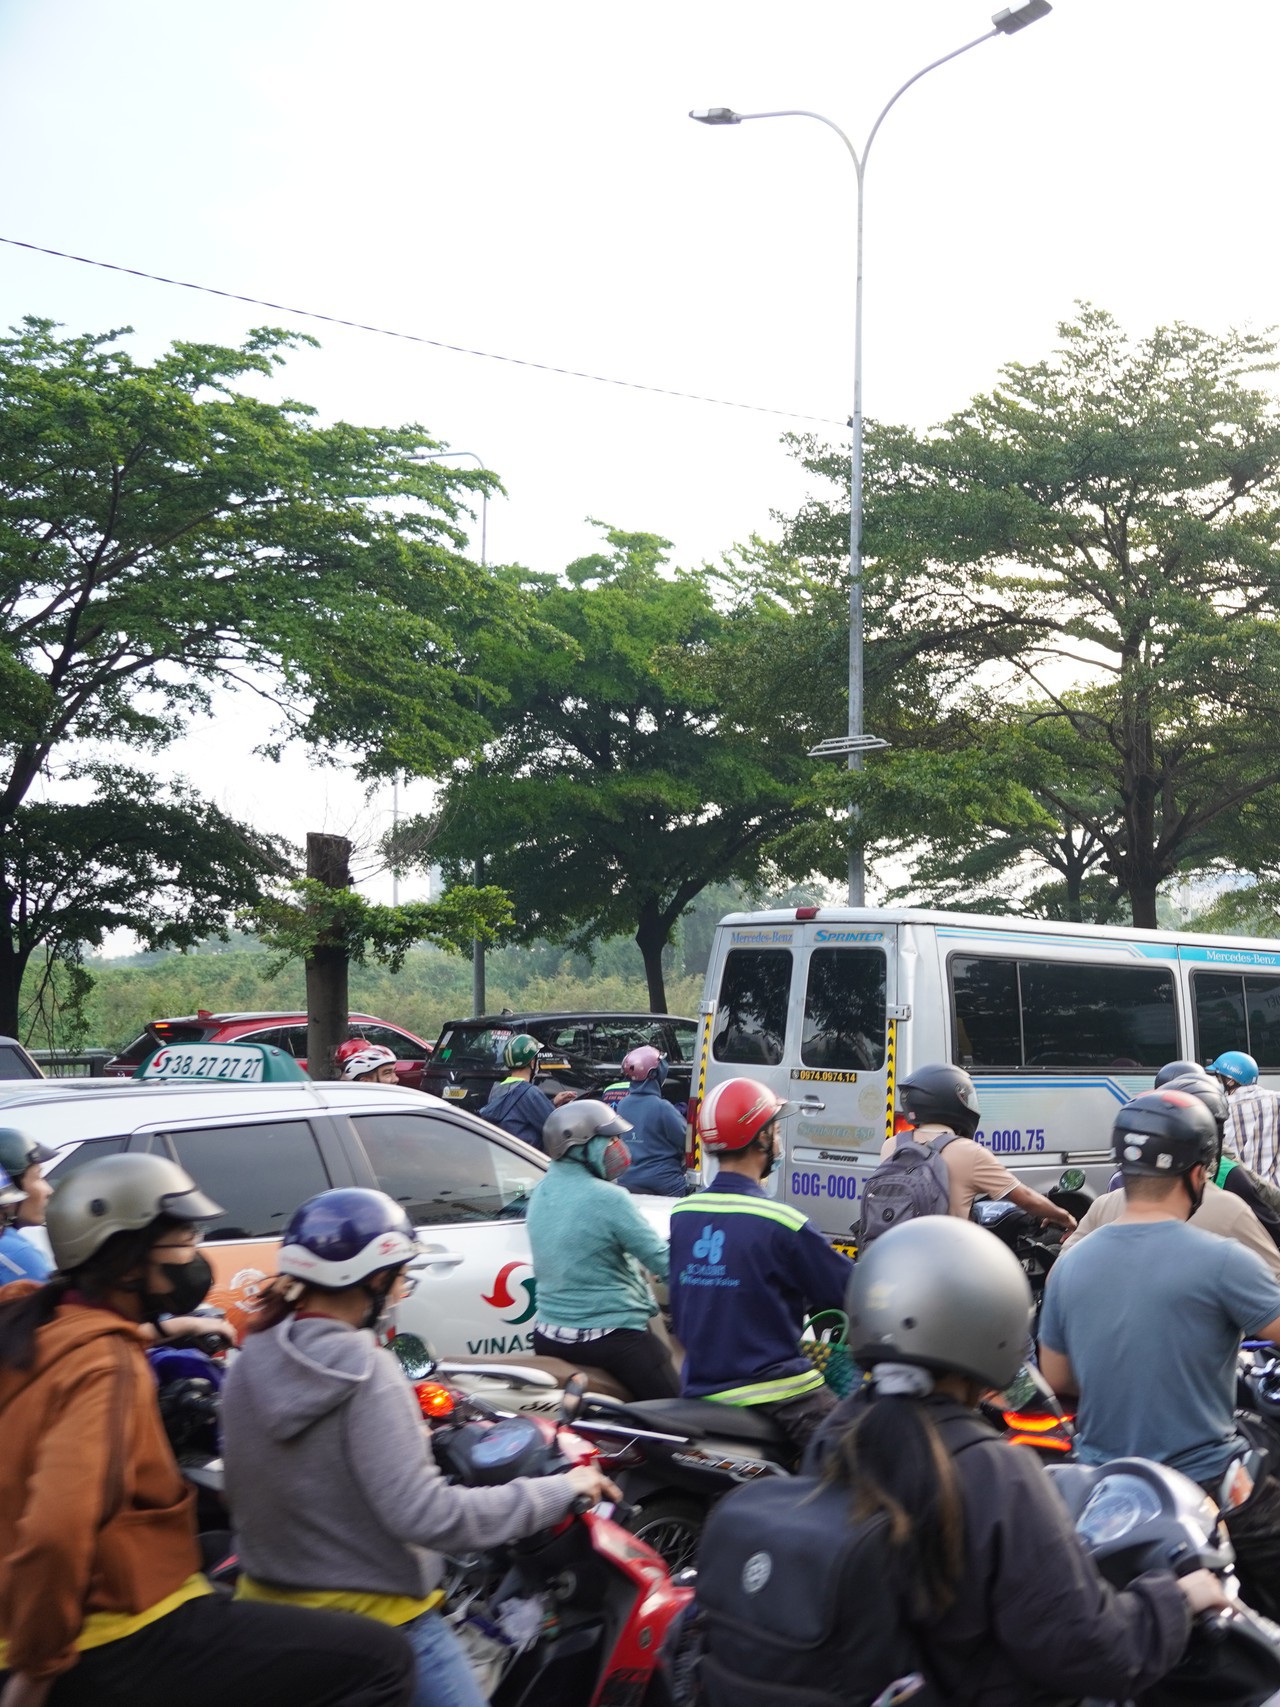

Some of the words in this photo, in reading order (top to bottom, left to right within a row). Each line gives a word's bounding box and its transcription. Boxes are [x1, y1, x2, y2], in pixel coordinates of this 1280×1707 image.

[731, 931, 793, 943] Mercedes-Benz
[815, 929, 883, 942] SPRINTER
[1206, 950, 1276, 964] Mercedes-Benz
[171, 1055, 217, 1076] 38.27
[220, 1058, 240, 1078] 27
[241, 1058, 263, 1079] 27
[800, 1069, 856, 1083] 0974.0974.14
[974, 1128, 1045, 1152] G-000.75
[791, 1171, 869, 1200] 60G-000.
[467, 1332, 536, 1355] VINAS
